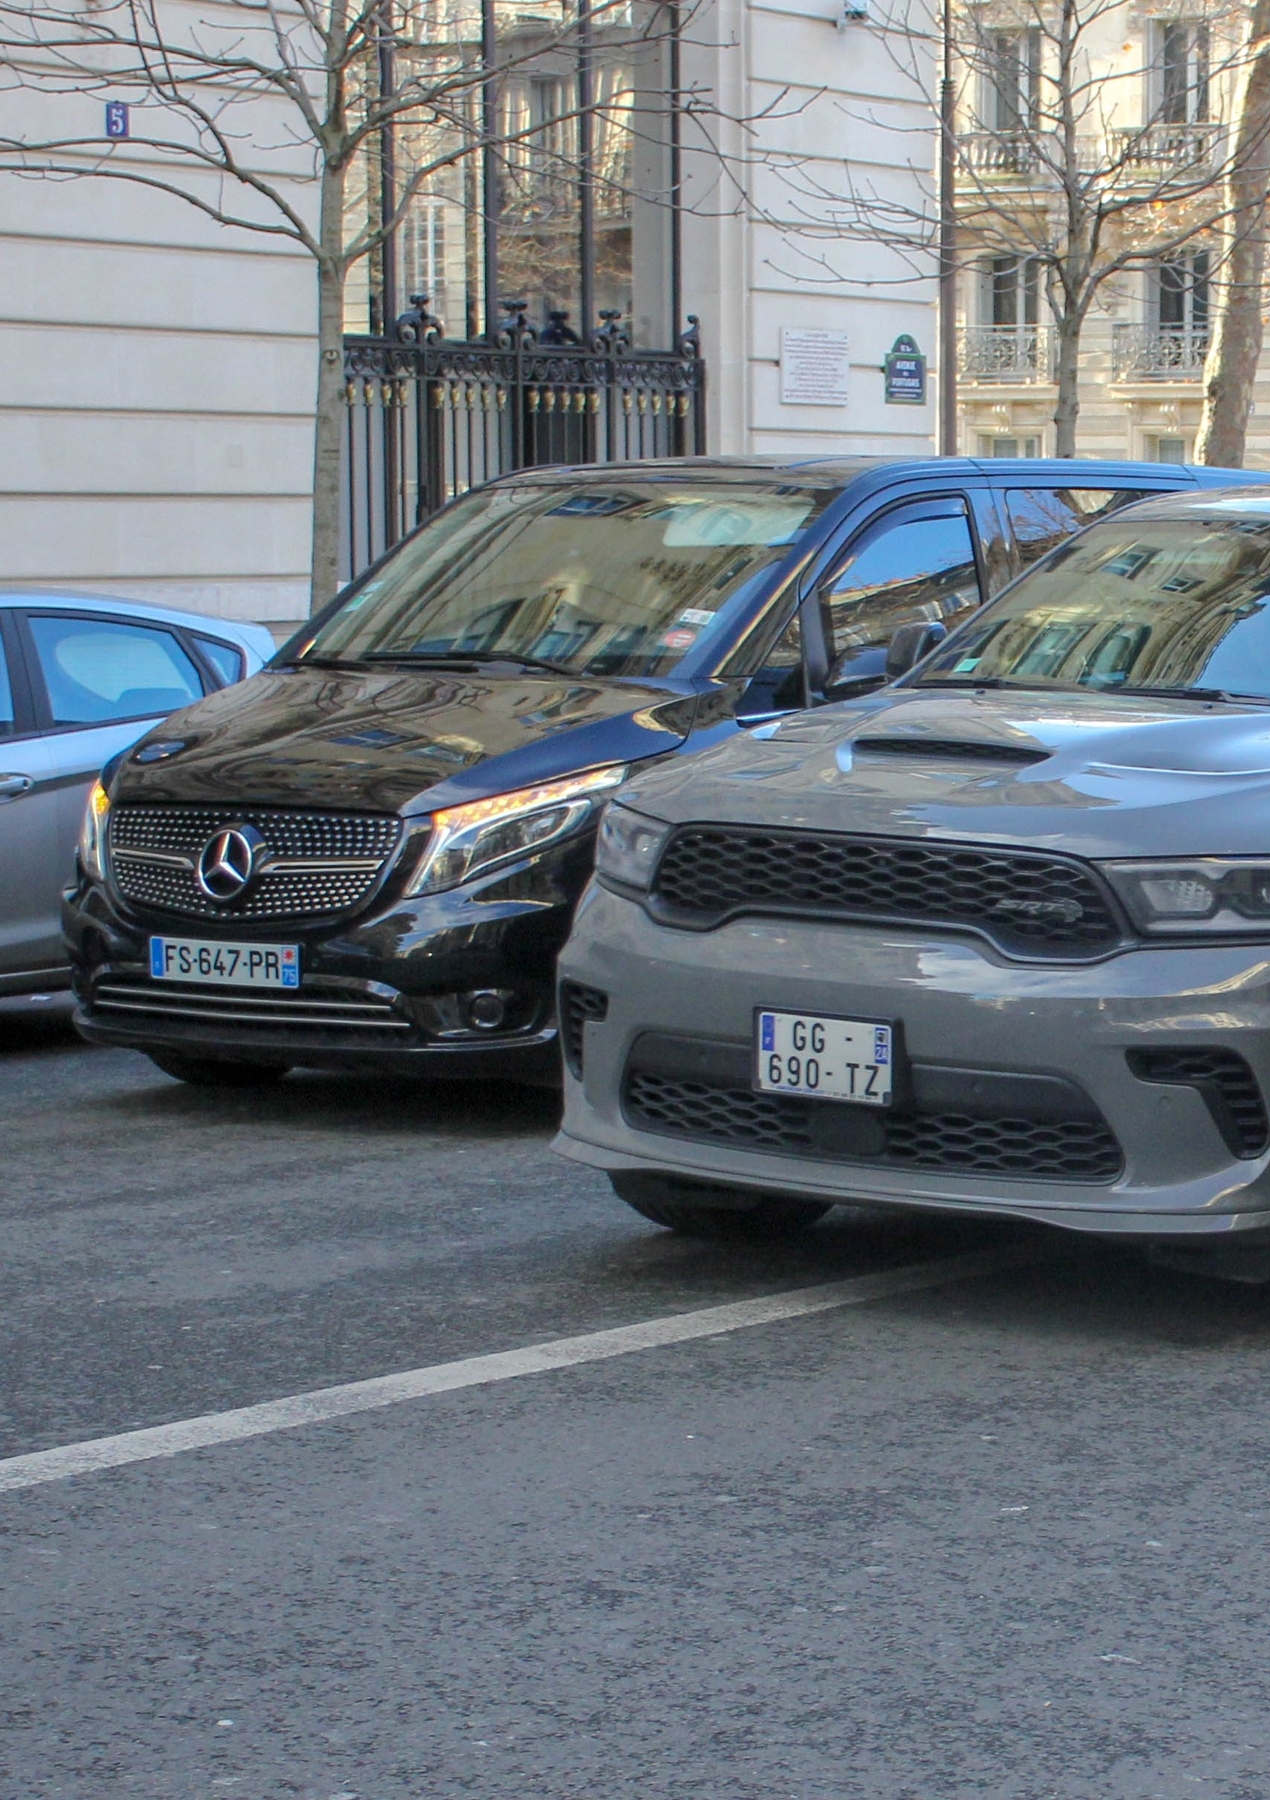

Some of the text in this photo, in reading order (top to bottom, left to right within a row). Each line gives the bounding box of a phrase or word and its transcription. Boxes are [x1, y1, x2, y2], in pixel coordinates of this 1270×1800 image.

[111, 108, 124, 134] 5
[995, 899, 1065, 914] SRT
[164, 944, 280, 980] FS-647-PR
[282, 968, 297, 984] 75
